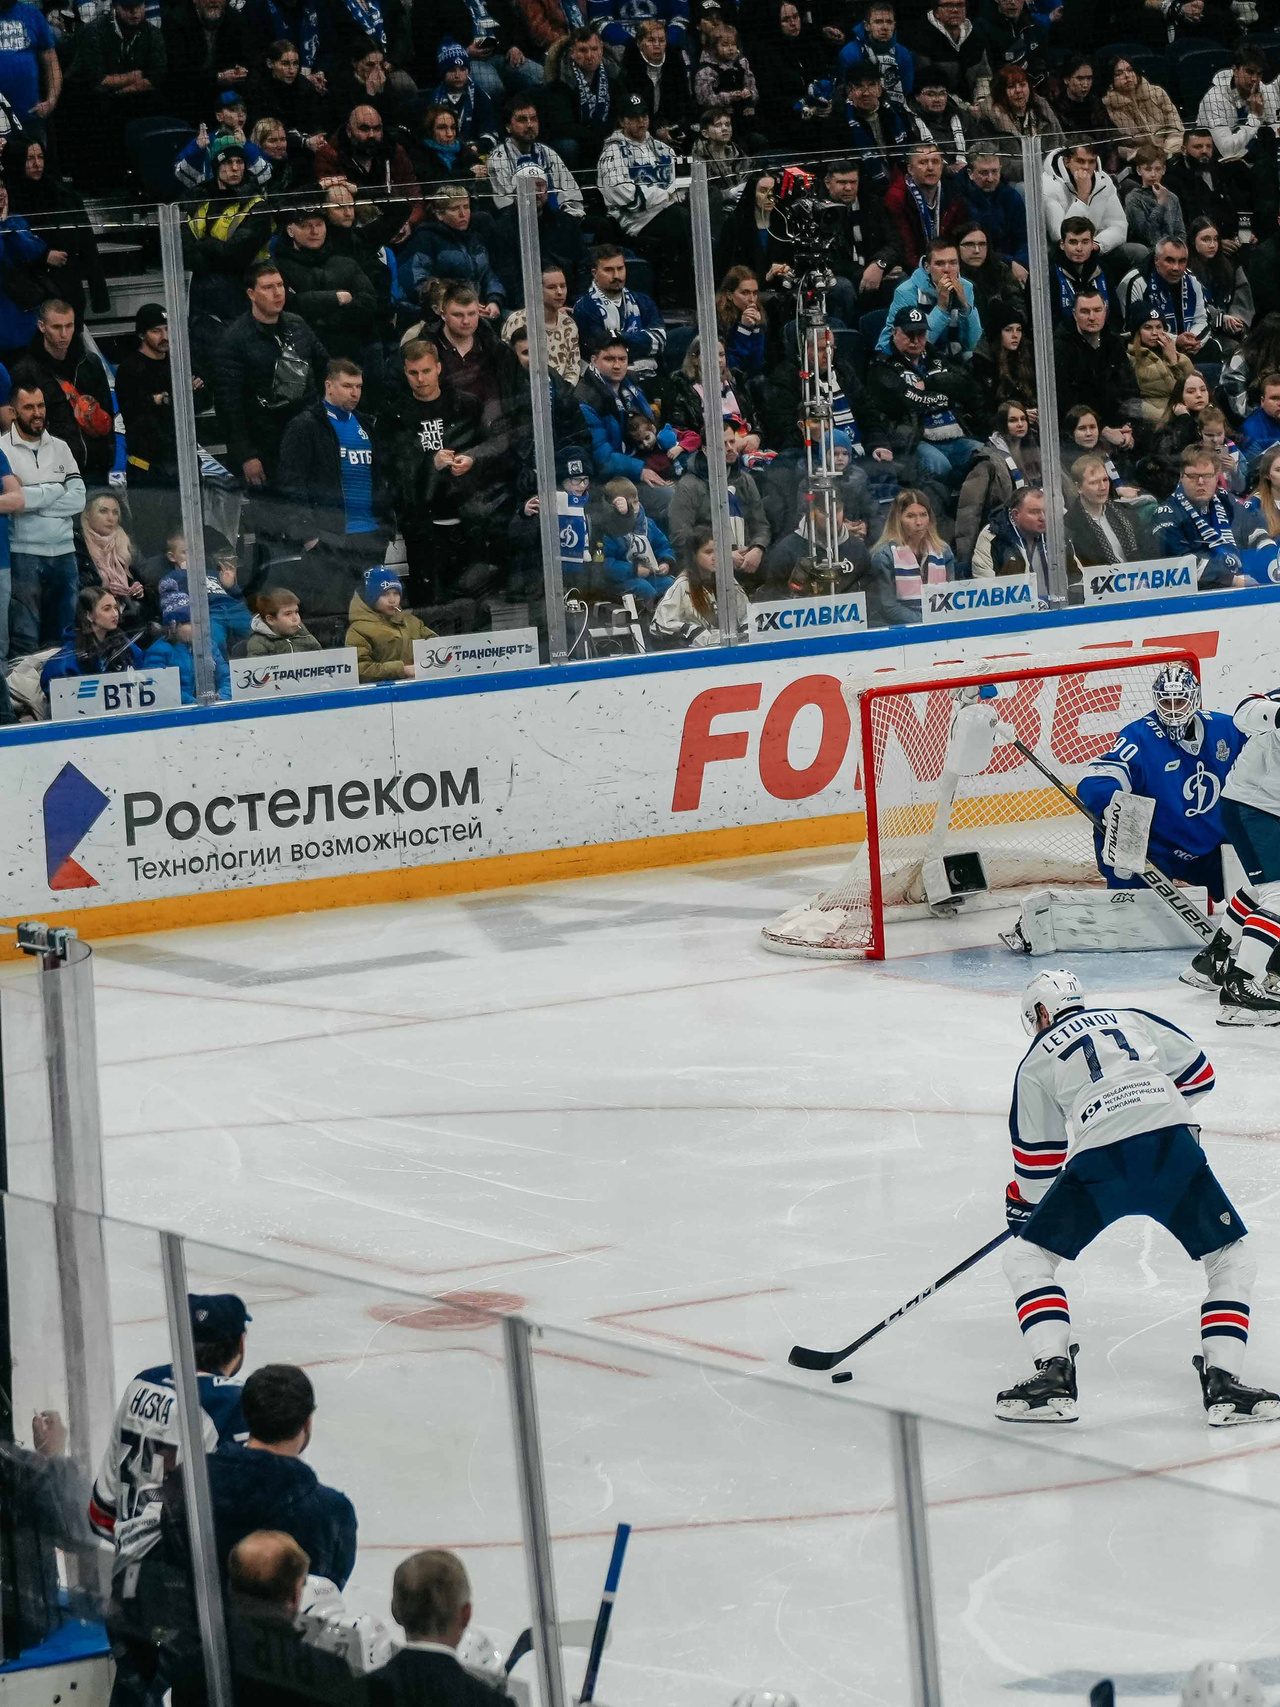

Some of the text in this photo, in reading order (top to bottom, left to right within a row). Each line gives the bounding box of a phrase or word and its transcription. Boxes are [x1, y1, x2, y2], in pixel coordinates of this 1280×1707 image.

[420, 419, 443, 430] THE
[348, 450, 372, 465] ВТБ
[455, 643, 533, 662] ТРАНСНЕФТЬ
[272, 664, 351, 682] ТРАНСНЕФТЬ
[103, 678, 156, 710] ВТБ
[1109, 736, 1139, 762] 90
[123, 767, 481, 847] Ростелеком
[127, 818, 483, 882] Технологии возможностей
[1042, 1012, 1119, 1054] LETUNOV
[1057, 1028, 1140, 1084] 71
